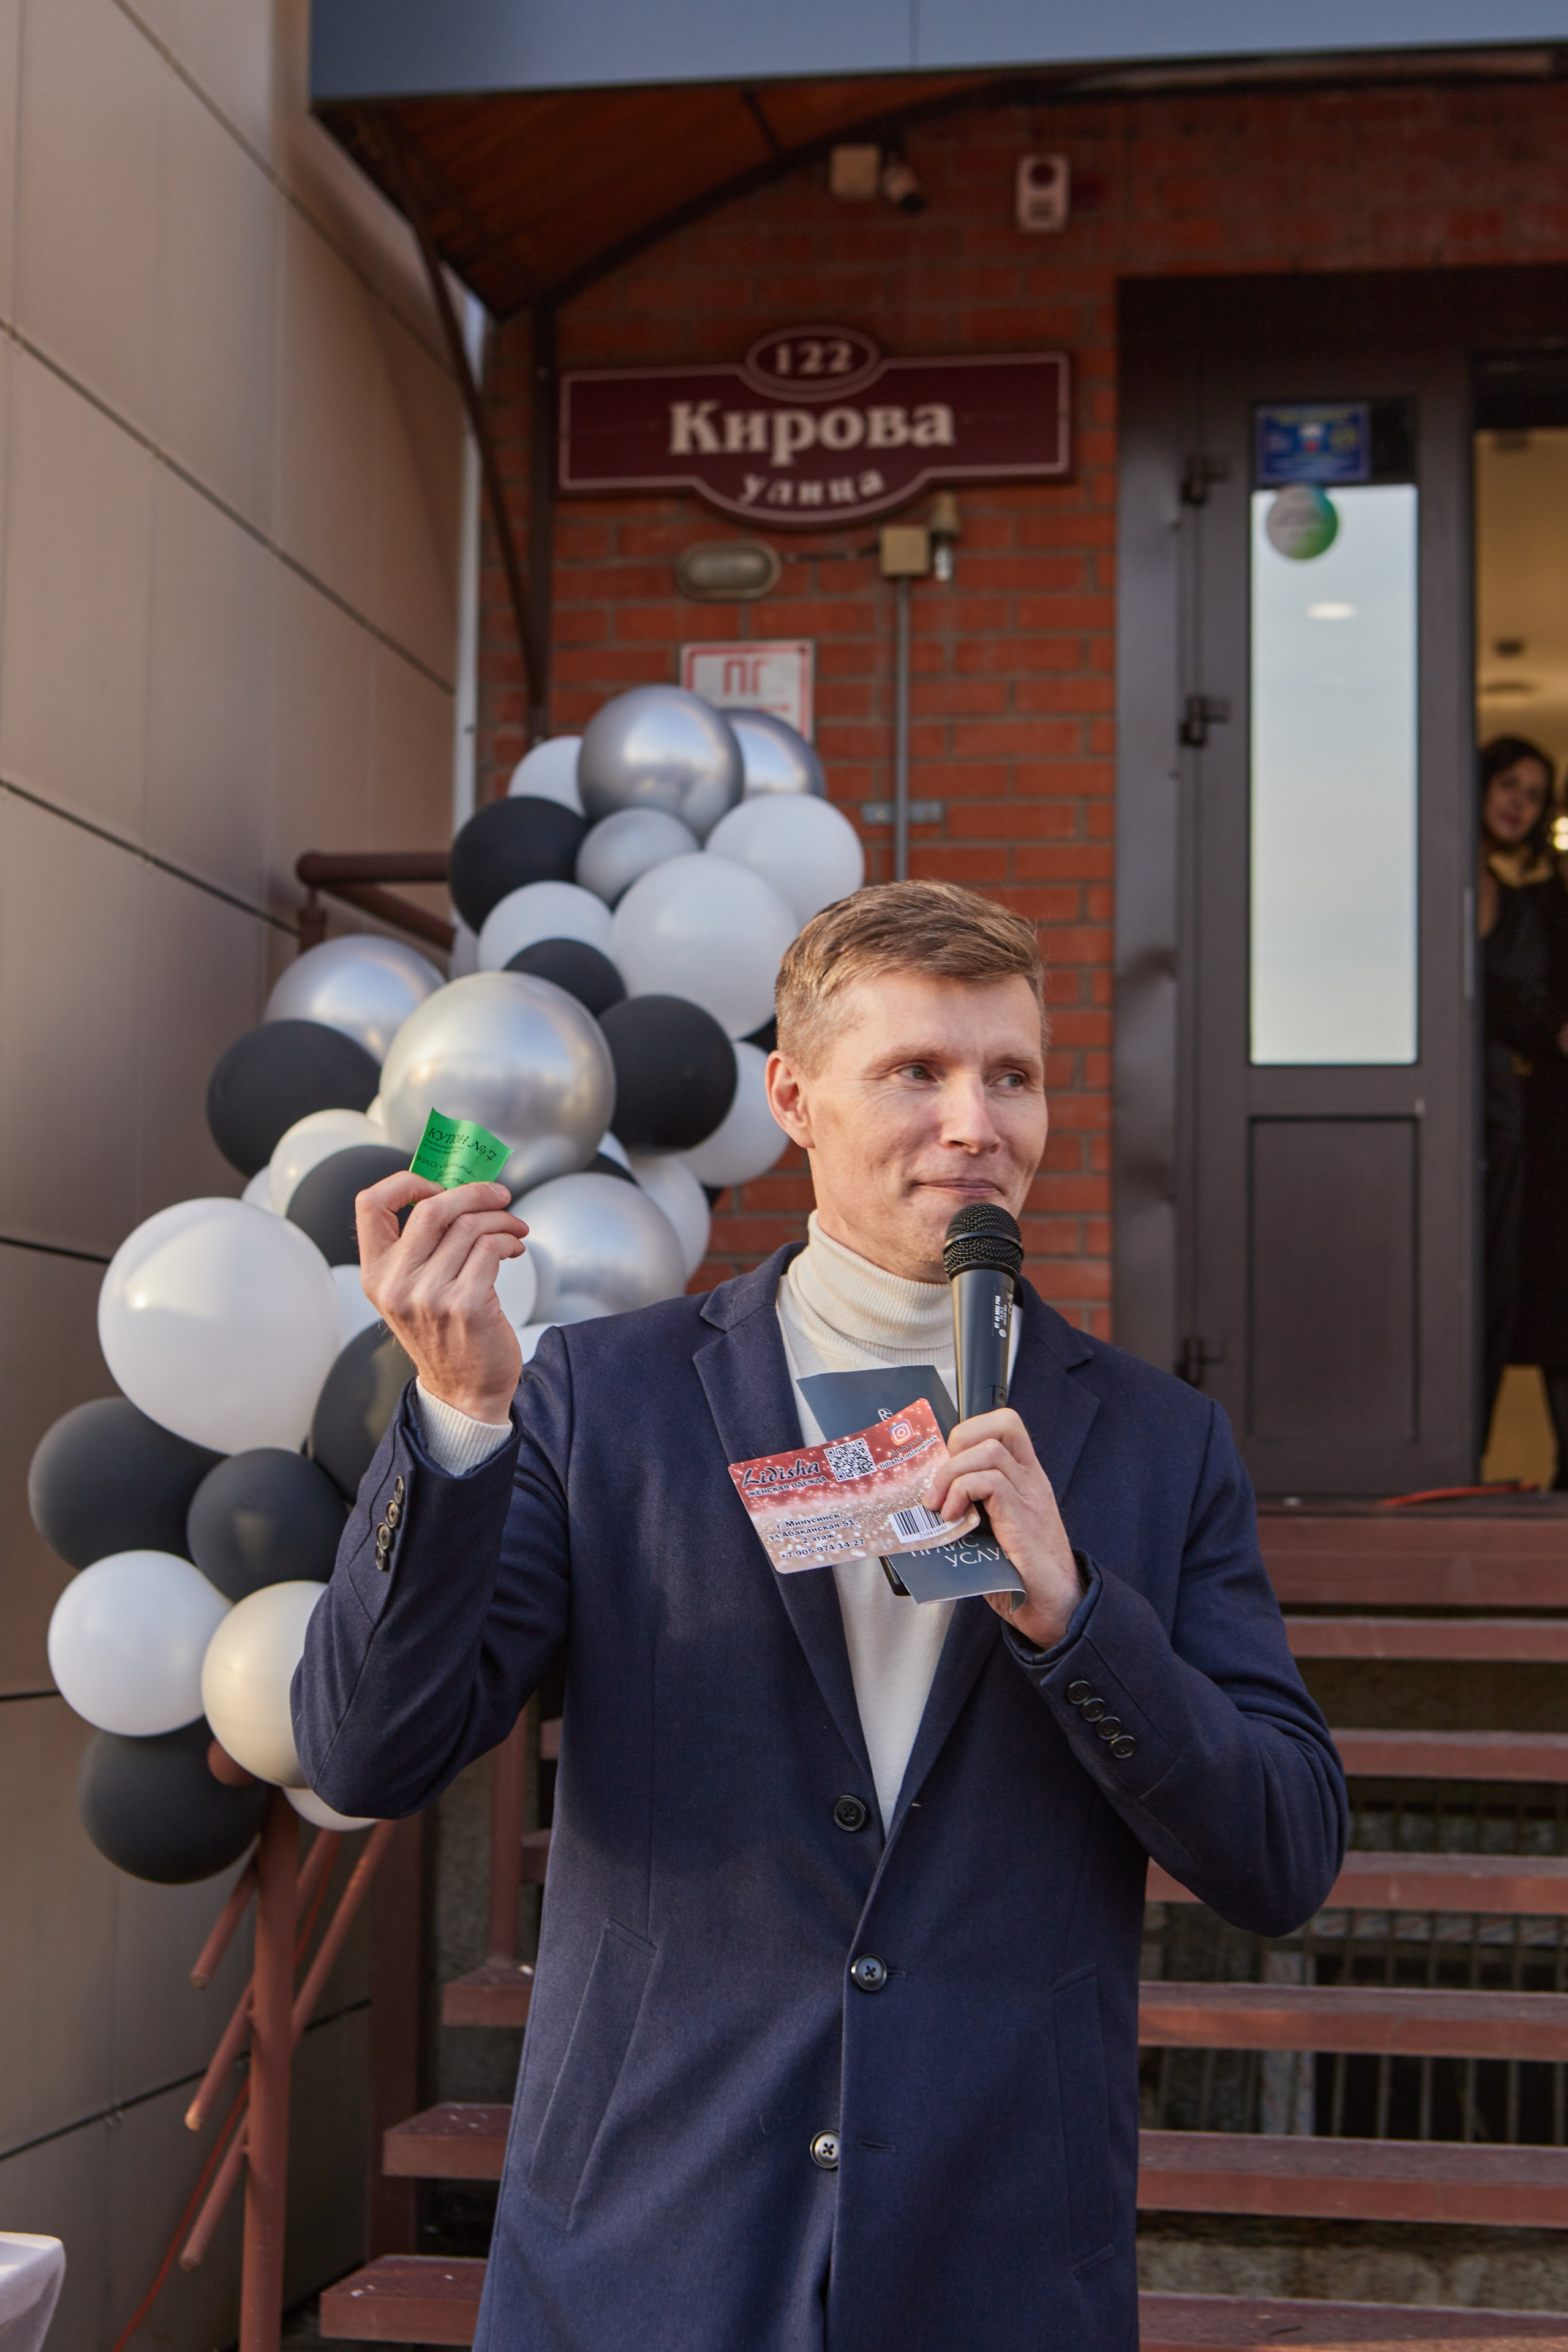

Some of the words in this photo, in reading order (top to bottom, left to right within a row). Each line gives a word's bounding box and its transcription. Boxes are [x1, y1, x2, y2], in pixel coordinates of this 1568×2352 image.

[775, 341, 853, 375] 122
[669, 399, 955, 467] Кирова
[738, 468, 886, 508] улица
[723, 659, 769, 695] ПГ
[428, 1127, 470, 1145] КУПОН
[742, 1459, 820, 1488] Lidisha
[748, 1484, 790, 1496] ЖЕНСКАЯ
[791, 1476, 827, 1488] ОДЕЖДА
[782, 1523, 840, 1538] Абаканская
[811, 1534, 835, 1542] этаж
